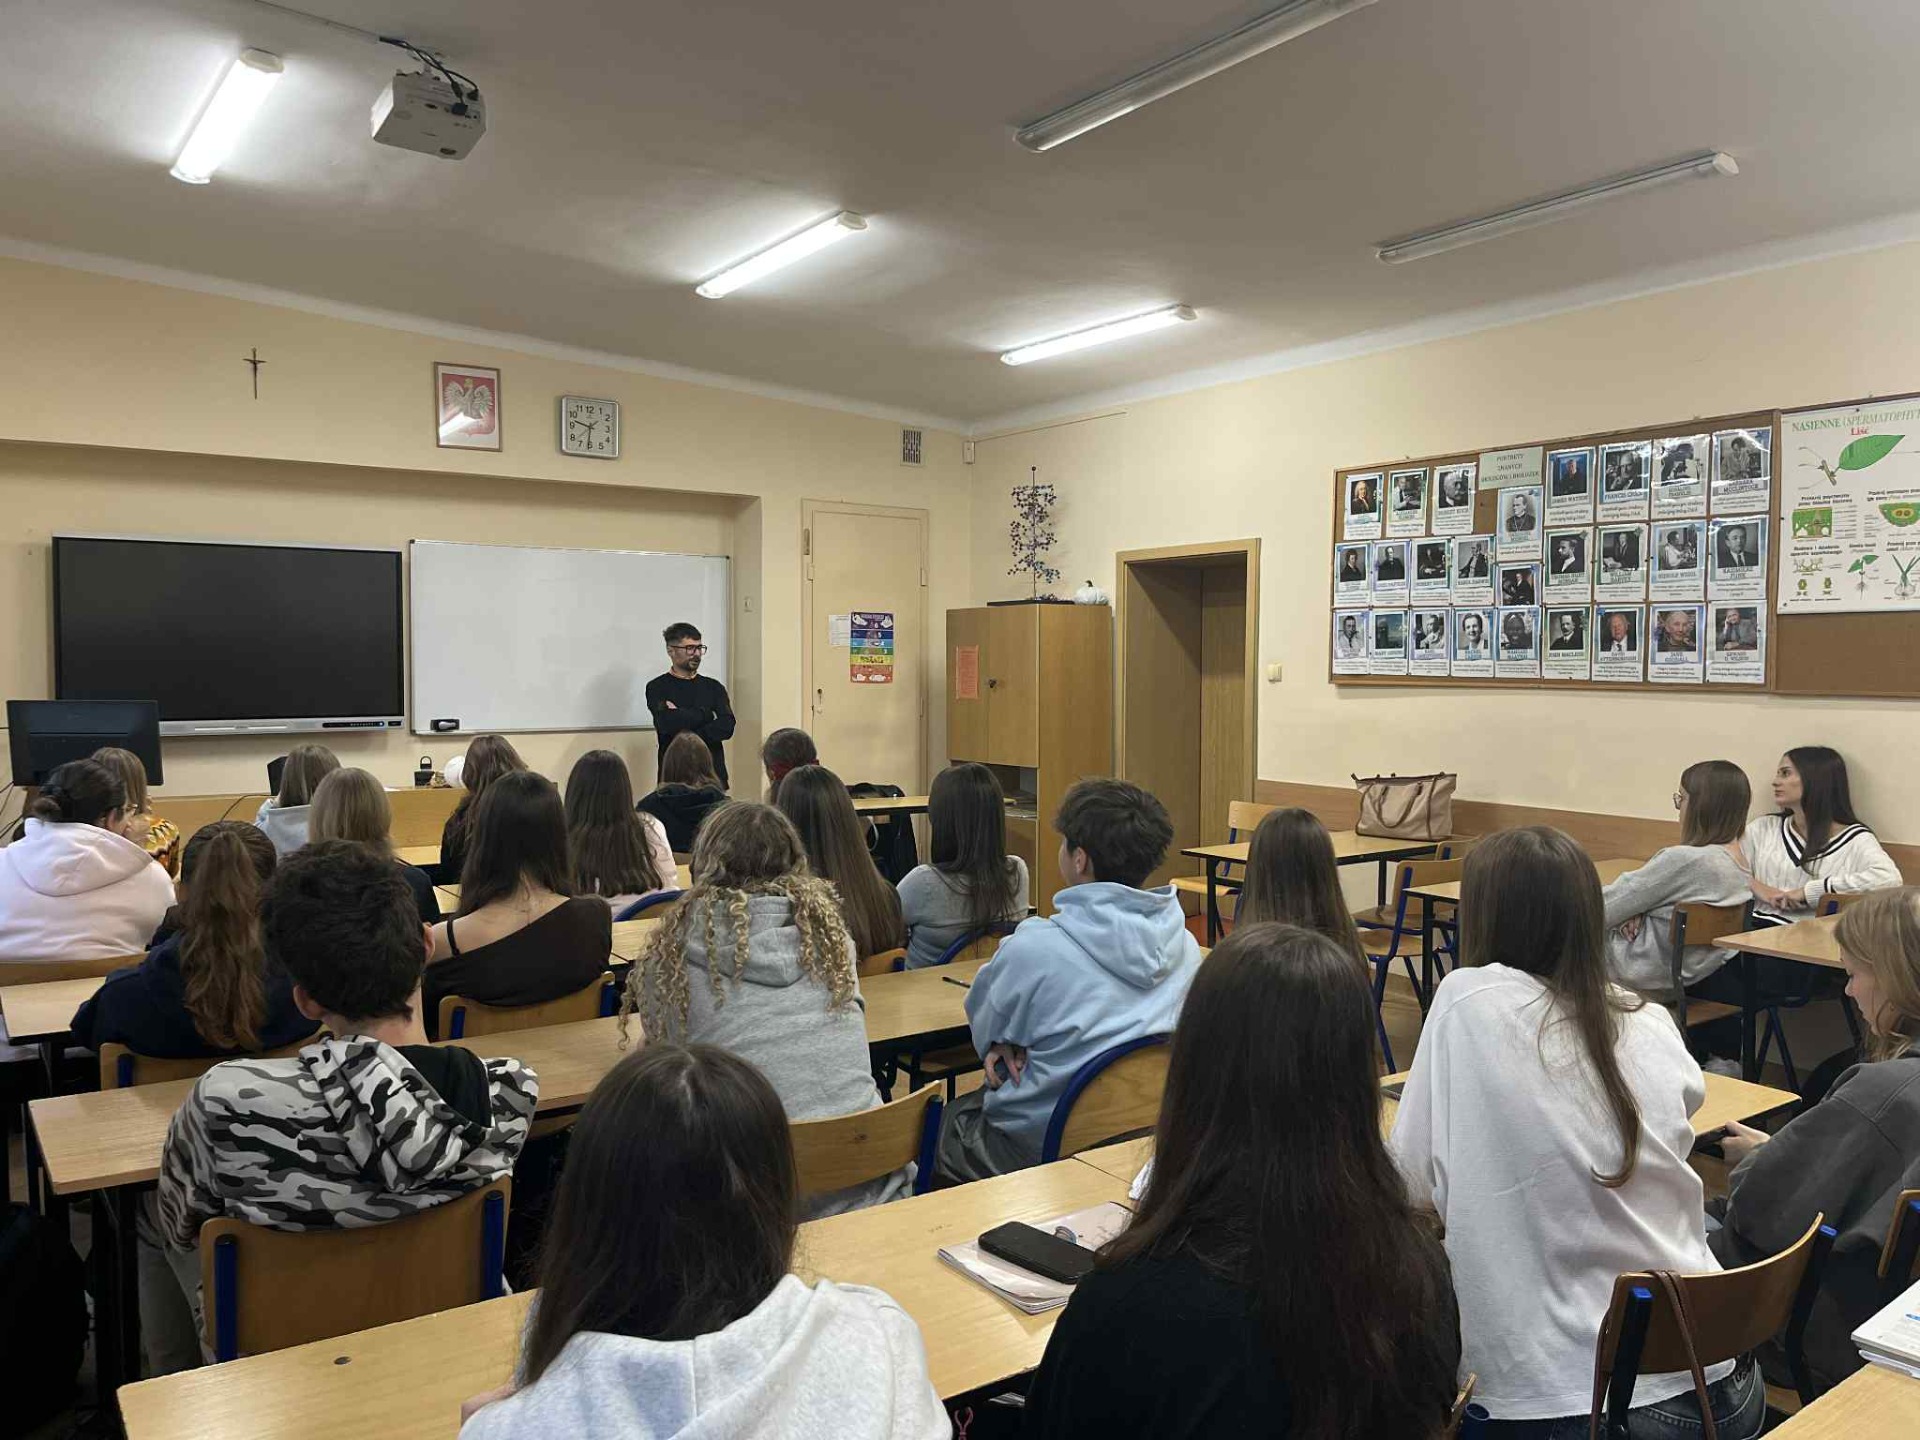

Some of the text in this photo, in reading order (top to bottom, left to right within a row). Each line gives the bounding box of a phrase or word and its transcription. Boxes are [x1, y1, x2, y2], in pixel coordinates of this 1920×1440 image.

[585, 405, 595, 414] 12
[605, 414, 611, 422] 2
[569, 421, 575, 429] 9
[605, 425, 610, 433] 3
[1792, 418, 1841, 432] NASIENNE
[570, 433, 576, 441] 8
[598, 442, 604, 450] 5
